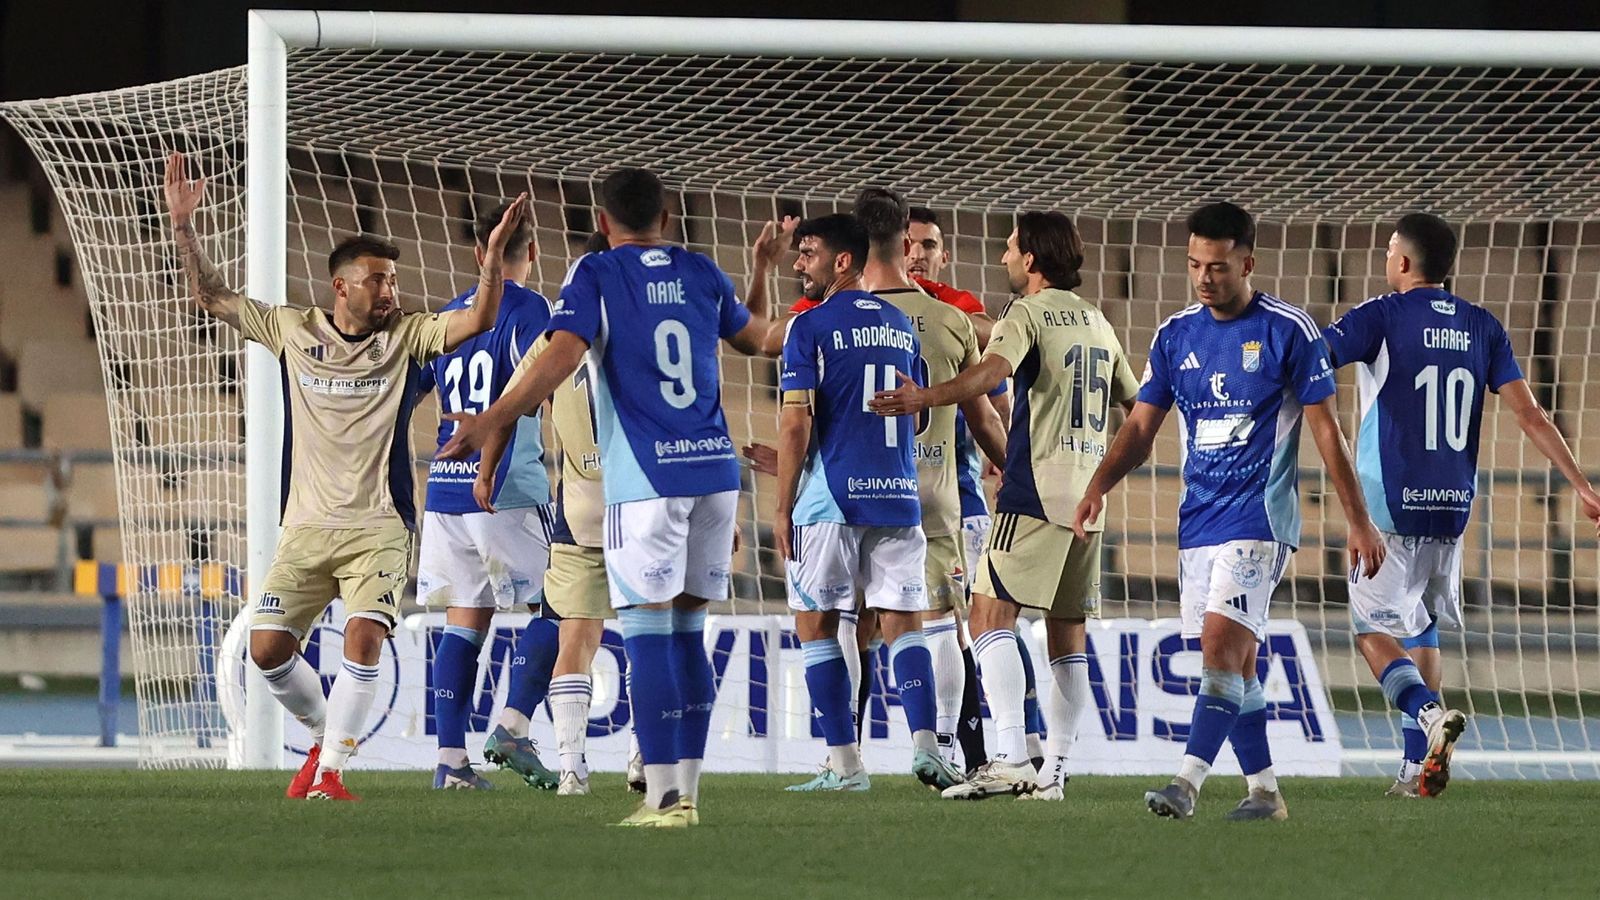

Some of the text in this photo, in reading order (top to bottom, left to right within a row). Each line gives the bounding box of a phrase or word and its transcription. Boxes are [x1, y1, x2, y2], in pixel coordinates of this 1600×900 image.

[832, 329, 848, 350] A.
[852, 323, 914, 353] RODRÍGUEZ
[1043, 311, 1077, 327] ALEX
[1423, 328, 1472, 352] CHARAF
[445, 349, 494, 436] 19
[654, 319, 697, 409] 9
[862, 364, 898, 447] 4
[1063, 343, 1110, 433] 15
[1414, 365, 1475, 452] 10
